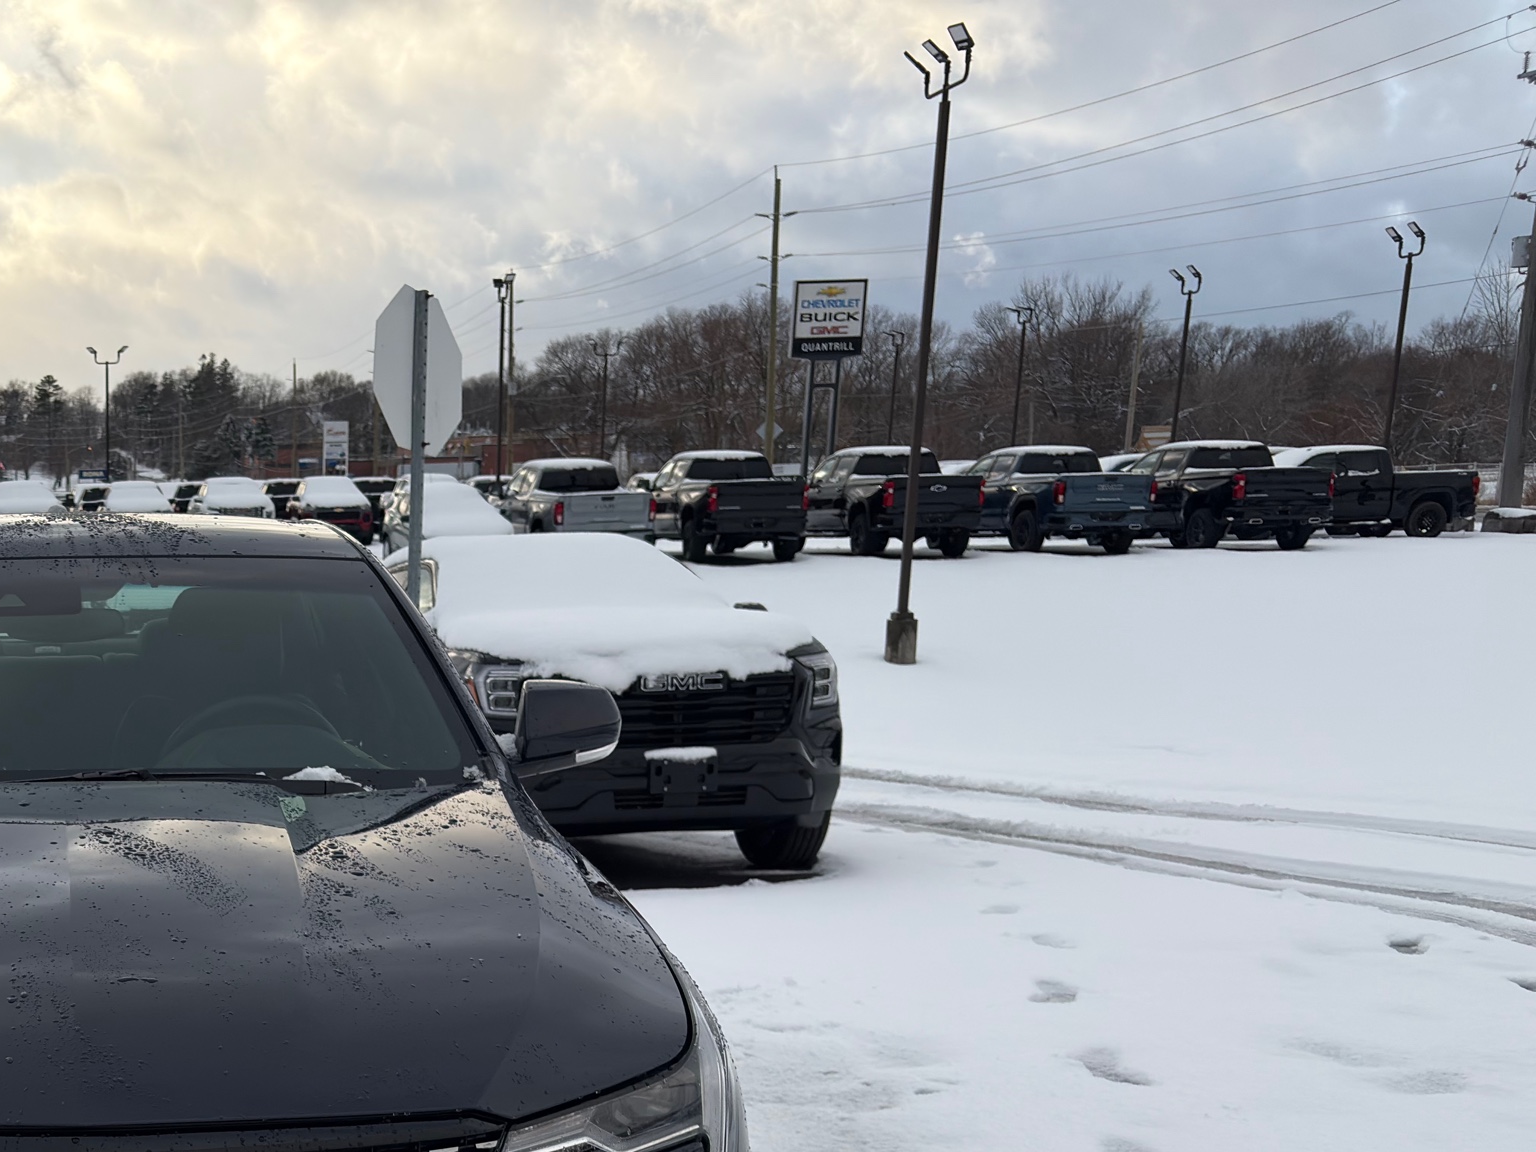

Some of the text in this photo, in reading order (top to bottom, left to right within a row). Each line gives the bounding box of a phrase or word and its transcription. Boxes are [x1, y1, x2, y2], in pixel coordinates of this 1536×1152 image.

[801, 299, 861, 309] CHEVROLET
[800, 312, 860, 323] BUICK
[810, 325, 848, 335] GMC
[801, 341, 855, 352] QUANTRILL
[640, 672, 724, 692] GMC
